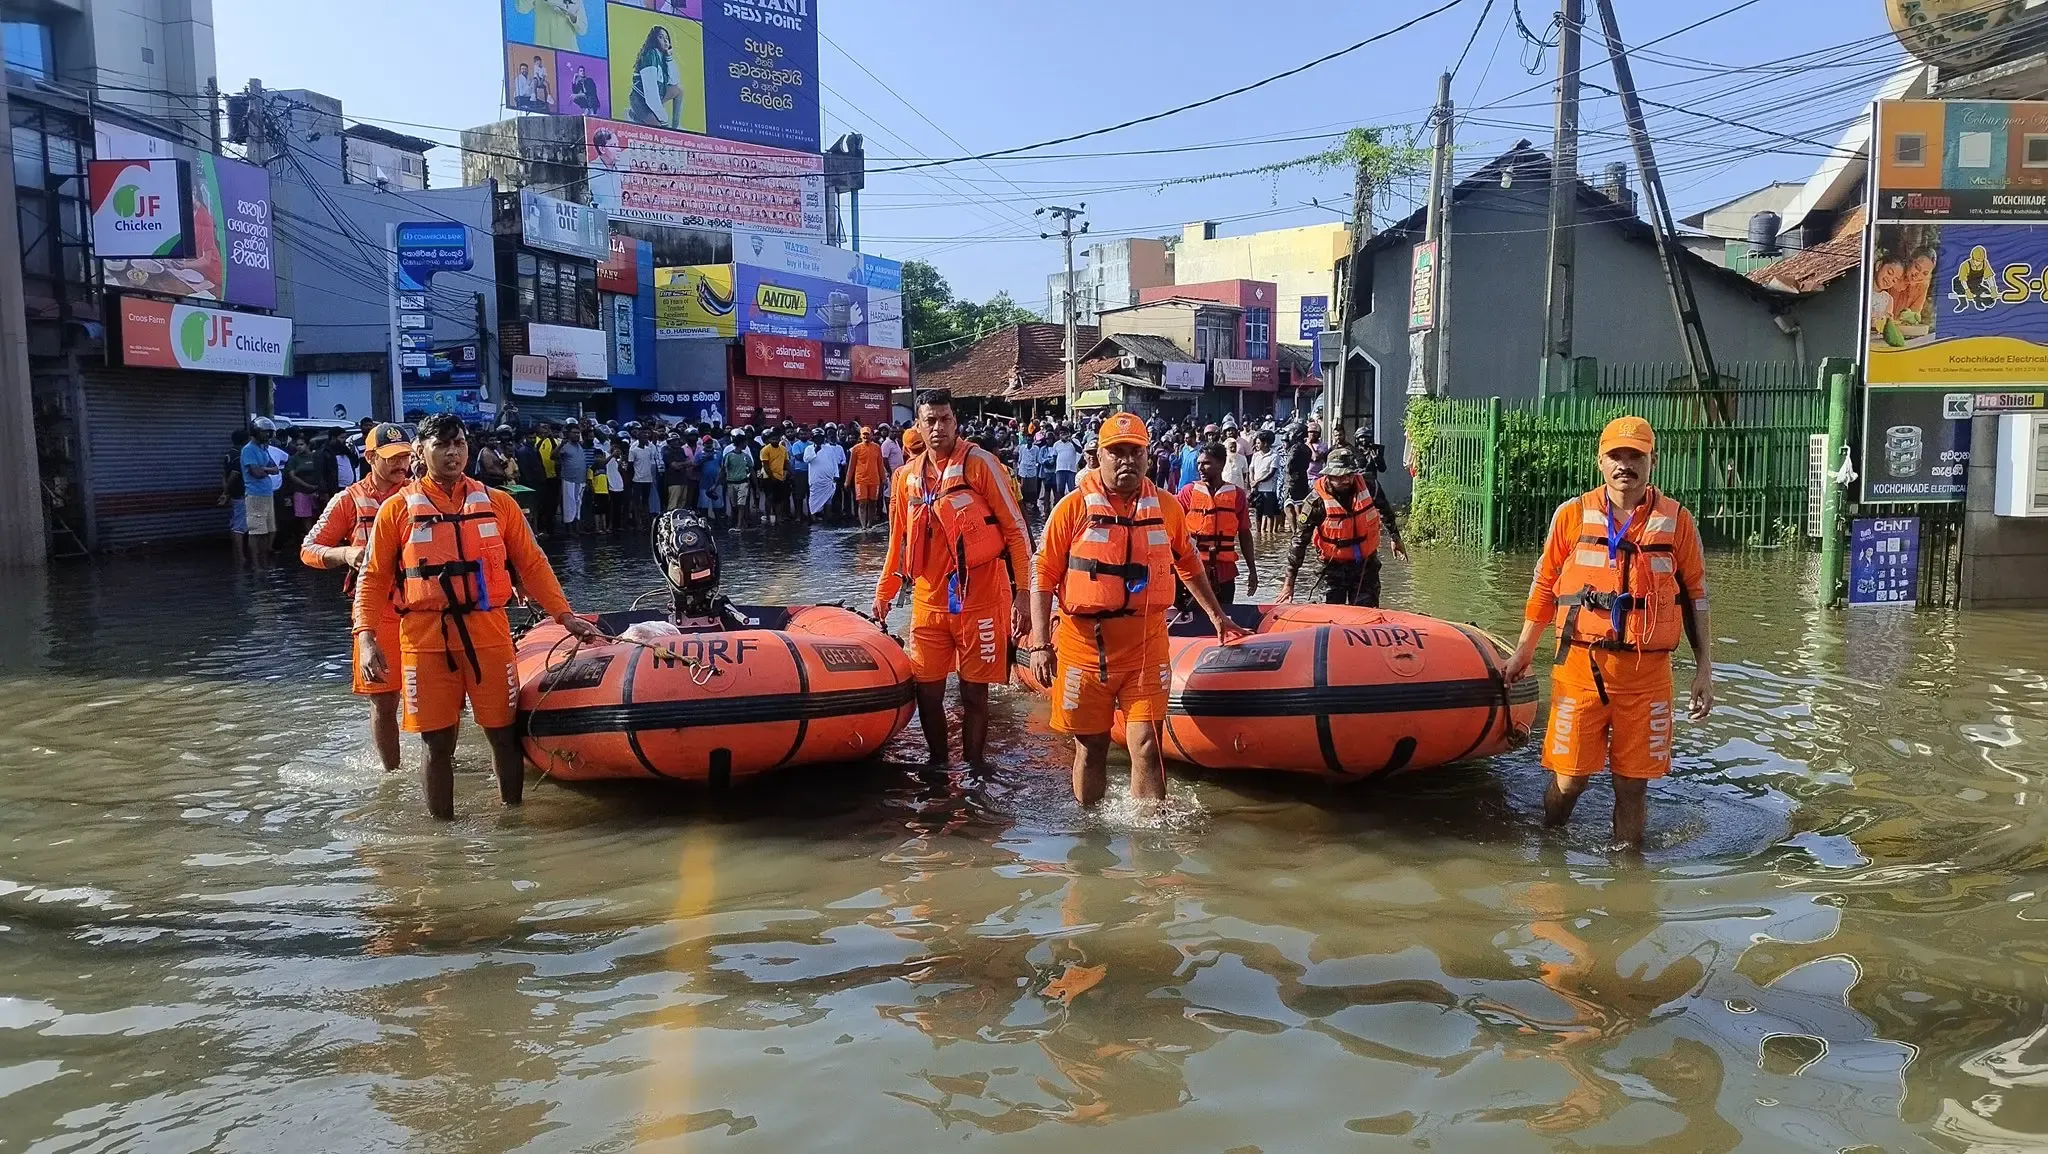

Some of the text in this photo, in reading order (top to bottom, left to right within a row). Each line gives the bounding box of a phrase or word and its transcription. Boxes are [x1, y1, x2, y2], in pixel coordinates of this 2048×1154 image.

[724, 2, 762, 23] DRESS
[744, 37, 784, 57] Style
[739, 87, 793, 111] සියල්ලයි
[755, 123, 780, 132] NEGOMBO
[1960, 108, 2000, 126] Colour
[2002, 116, 2026, 131] your
[719, 124, 754, 135] KURUNEGALA
[134, 195, 160, 218] JF
[1908, 196, 1951, 209] KEVILTON
[1992, 195, 2046, 206] KOCHCHIKADE
[555, 203, 578, 219] AXE
[619, 208, 674, 222] ECONOMICS
[114, 220, 162, 231] Chicken
[559, 216, 578, 233] OIL
[874, 265, 900, 277] HARDWARE
[762, 290, 801, 311] ANTON
[128, 313, 166, 325] Croos Farm
[207, 314, 233, 348] JF
[235, 335, 281, 354] Chicken
[775, 346, 811, 361] asianpaints
[1948, 355, 2005, 364] Kochchikade
[824, 358, 851, 367] HARDWARE
[1999, 394, 2035, 406] Shield
[1873, 483, 1930, 494] KOCHCHIKADE
[977, 617, 996, 663] NDRF
[1343, 627, 1430, 649] NDRF
[652, 638, 759, 669] NDRF
[402, 665, 419, 715] INDIA
[1551, 695, 1577, 755] INDIA
[1649, 700, 1669, 761] NDRF
